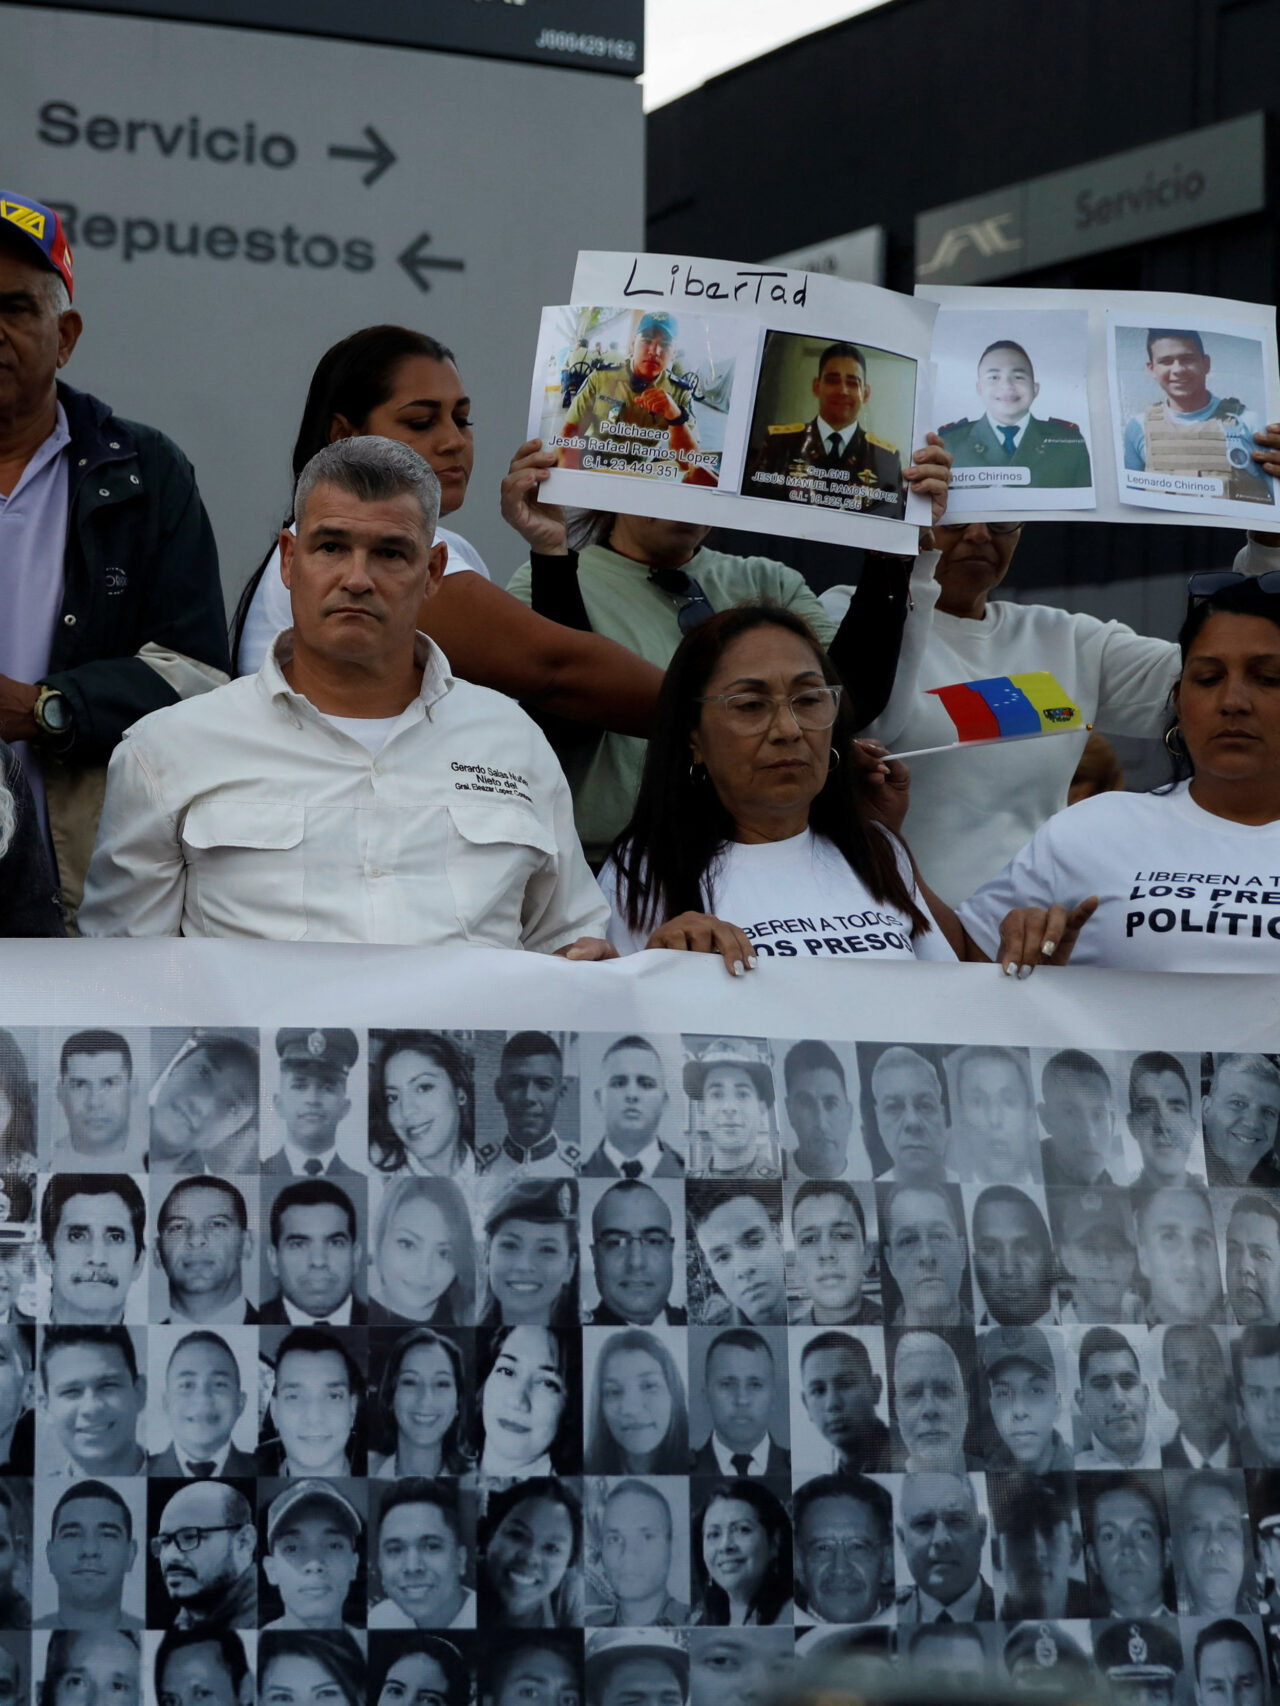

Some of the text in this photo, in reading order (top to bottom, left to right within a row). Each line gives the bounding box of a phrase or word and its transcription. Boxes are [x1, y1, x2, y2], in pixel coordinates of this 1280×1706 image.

[38, 101, 298, 170] Servicio
[1075, 163, 1207, 230] Servicio
[600, 421, 670, 441] Polichacao
[549, 435, 718, 466] Jesús Rafael Ramos López
[610, 459, 679, 478] 23.449.351
[951, 471, 1023, 482] ndro Chirinos
[751, 471, 898, 503] JESÚS MANUEL RAMOS LÓPEZ
[1127, 474, 1216, 492] Leonardo Chirinos
[451, 762, 486, 774] Gerardo
[487, 768, 509, 780] Salas
[476, 774, 518, 789] Nieto del
[1134, 871, 1240, 885] LIBEREN
[1245, 876, 1263, 886] A
[1129, 885, 1280, 905] LOS PRE
[744, 917, 817, 940] BEREN
[820, 917, 837, 931] A
[1126, 902, 1280, 940] POLÍTI
[752, 931, 913, 957] OS PRESOS
